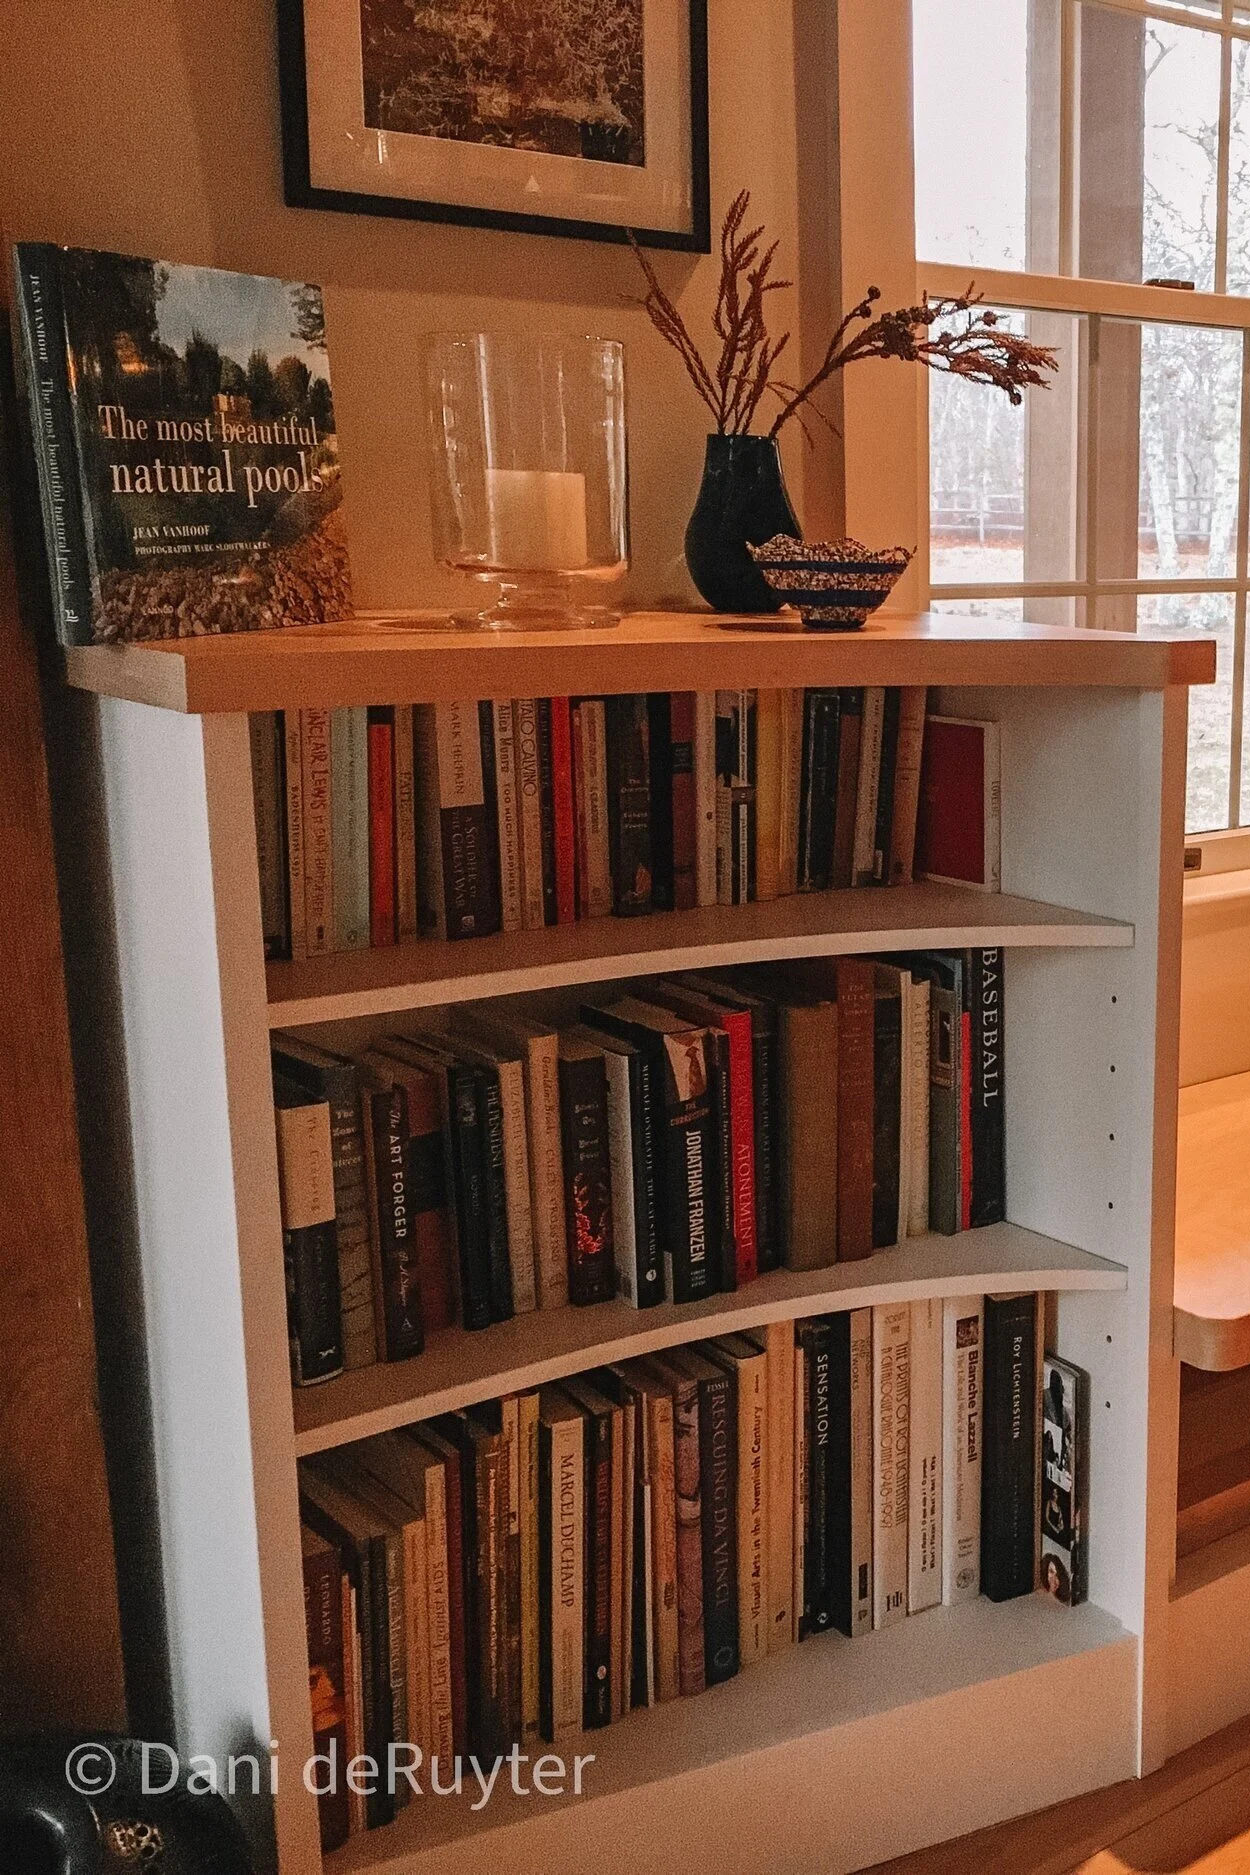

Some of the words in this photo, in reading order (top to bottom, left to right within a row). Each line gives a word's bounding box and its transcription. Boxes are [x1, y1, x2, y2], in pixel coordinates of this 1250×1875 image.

[98, 404, 149, 441] The
[156, 417, 214, 443] most
[219, 412, 320, 446] beautiful
[109, 449, 237, 494] natural
[243, 451, 324, 509] pools
[54, 506, 70, 553] natural
[132, 526, 160, 541] JEAN
[162, 524, 211, 538] VANHOOF
[134, 544, 192, 556] PHOTOGRAPHY
[56, 557, 75, 590] pools
[307, 706, 329, 764] INCLAIR
[499, 704, 512, 732] Alice
[520, 699, 535, 735] ITALO
[310, 770, 329, 811] LEWIS
[503, 783, 511, 804] TOO
[521, 739, 538, 797] CALVINO
[504, 807, 513, 837] MUCH
[464, 826, 478, 883] SOLDIER
[506, 840, 516, 898] HAPPINESS
[913, 1001, 923, 1068] ALBERTO
[981, 946, 1000, 1109] BASEBALL
[510, 1070, 523, 1139] ELIZABETH
[389, 1134, 402, 1164] ART
[685, 1130, 703, 1198] JONATHAN
[390, 1170, 408, 1238] FORGER
[736, 1142, 753, 1248] ATONEMENT
[688, 1199, 706, 1263] FRANZEN
[852, 1339, 860, 1391] NETWORKS
[1011, 1336, 1023, 1358] ROY
[816, 1353, 829, 1446] SENSATION
[880, 1355, 893, 1413] CATALOGUE
[895, 1362, 908, 1402] PRINTS
[967, 1349, 979, 1409] Blanche
[1012, 1362, 1022, 1440] LICHTENSTEIN
[711, 1394, 728, 1501] RESCUING
[751, 1405, 763, 1454] Century
[968, 1411, 979, 1464] Lazzell
[559, 1453, 575, 1522] MARCEL
[751, 1456, 761, 1515] Twentieth
[713, 1506, 728, 1538] DA
[751, 1517, 761, 1536] the
[751, 1540, 761, 1551] in
[433, 1561, 445, 1594] AIDS
[560, 1523, 575, 1608] DUCHAMP
[713, 1542, 730, 1609] VINCI
[750, 1553, 761, 1579] Arts
[319, 1573, 332, 1646] LEONARDO
[434, 1600, 449, 1648] Against
[750, 1580, 761, 1619] Visual
[434, 1657, 447, 1687] Line
[437, 1713, 450, 1772] Drawing
